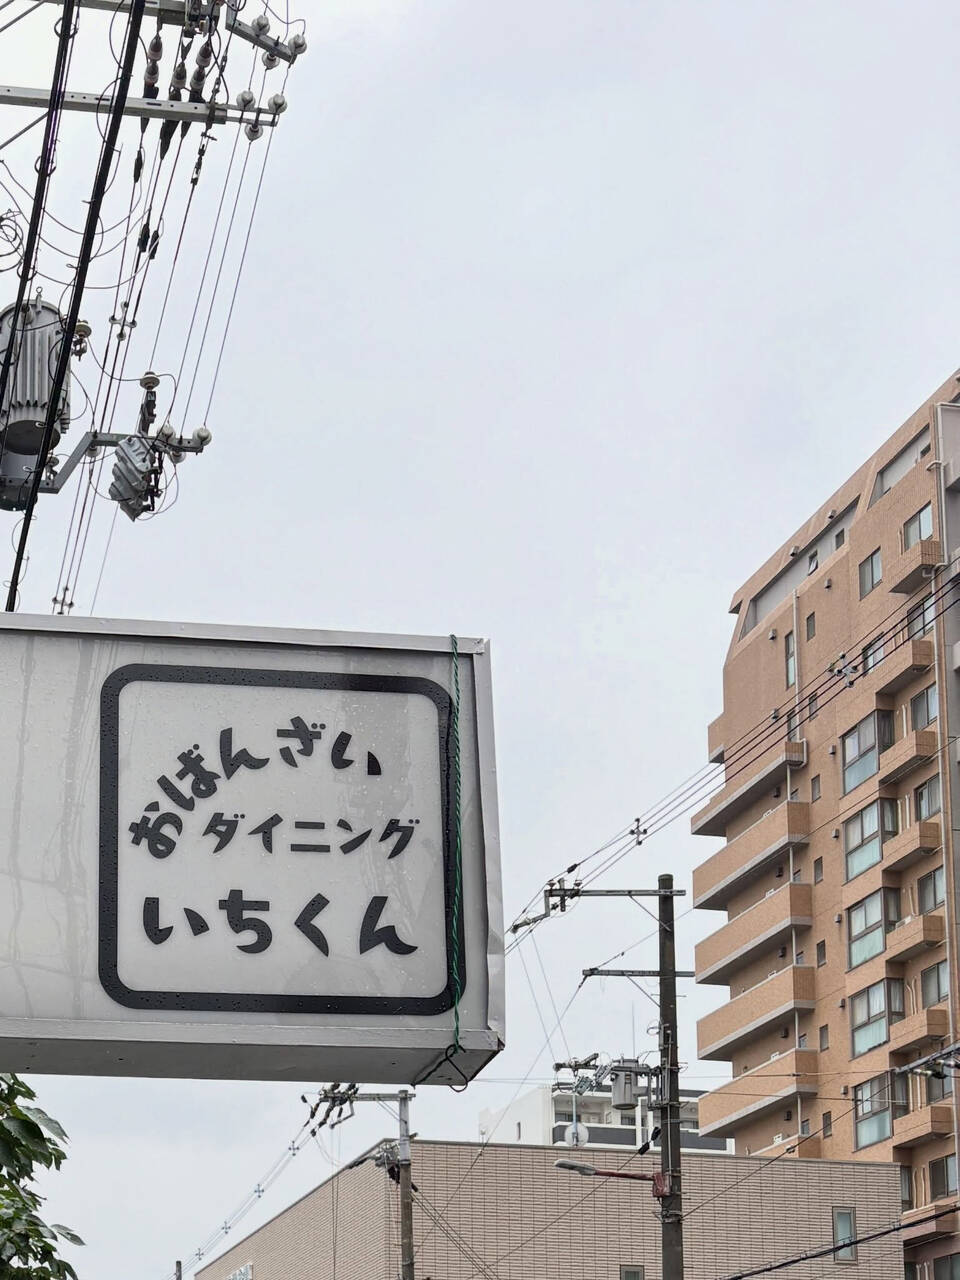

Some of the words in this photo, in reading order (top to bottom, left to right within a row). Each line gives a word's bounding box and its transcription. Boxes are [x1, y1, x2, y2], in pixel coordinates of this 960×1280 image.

[128, 716, 382, 859] おばんざい
[202, 813, 420, 860] ダイニング
[143, 889, 419, 957] いちくん
